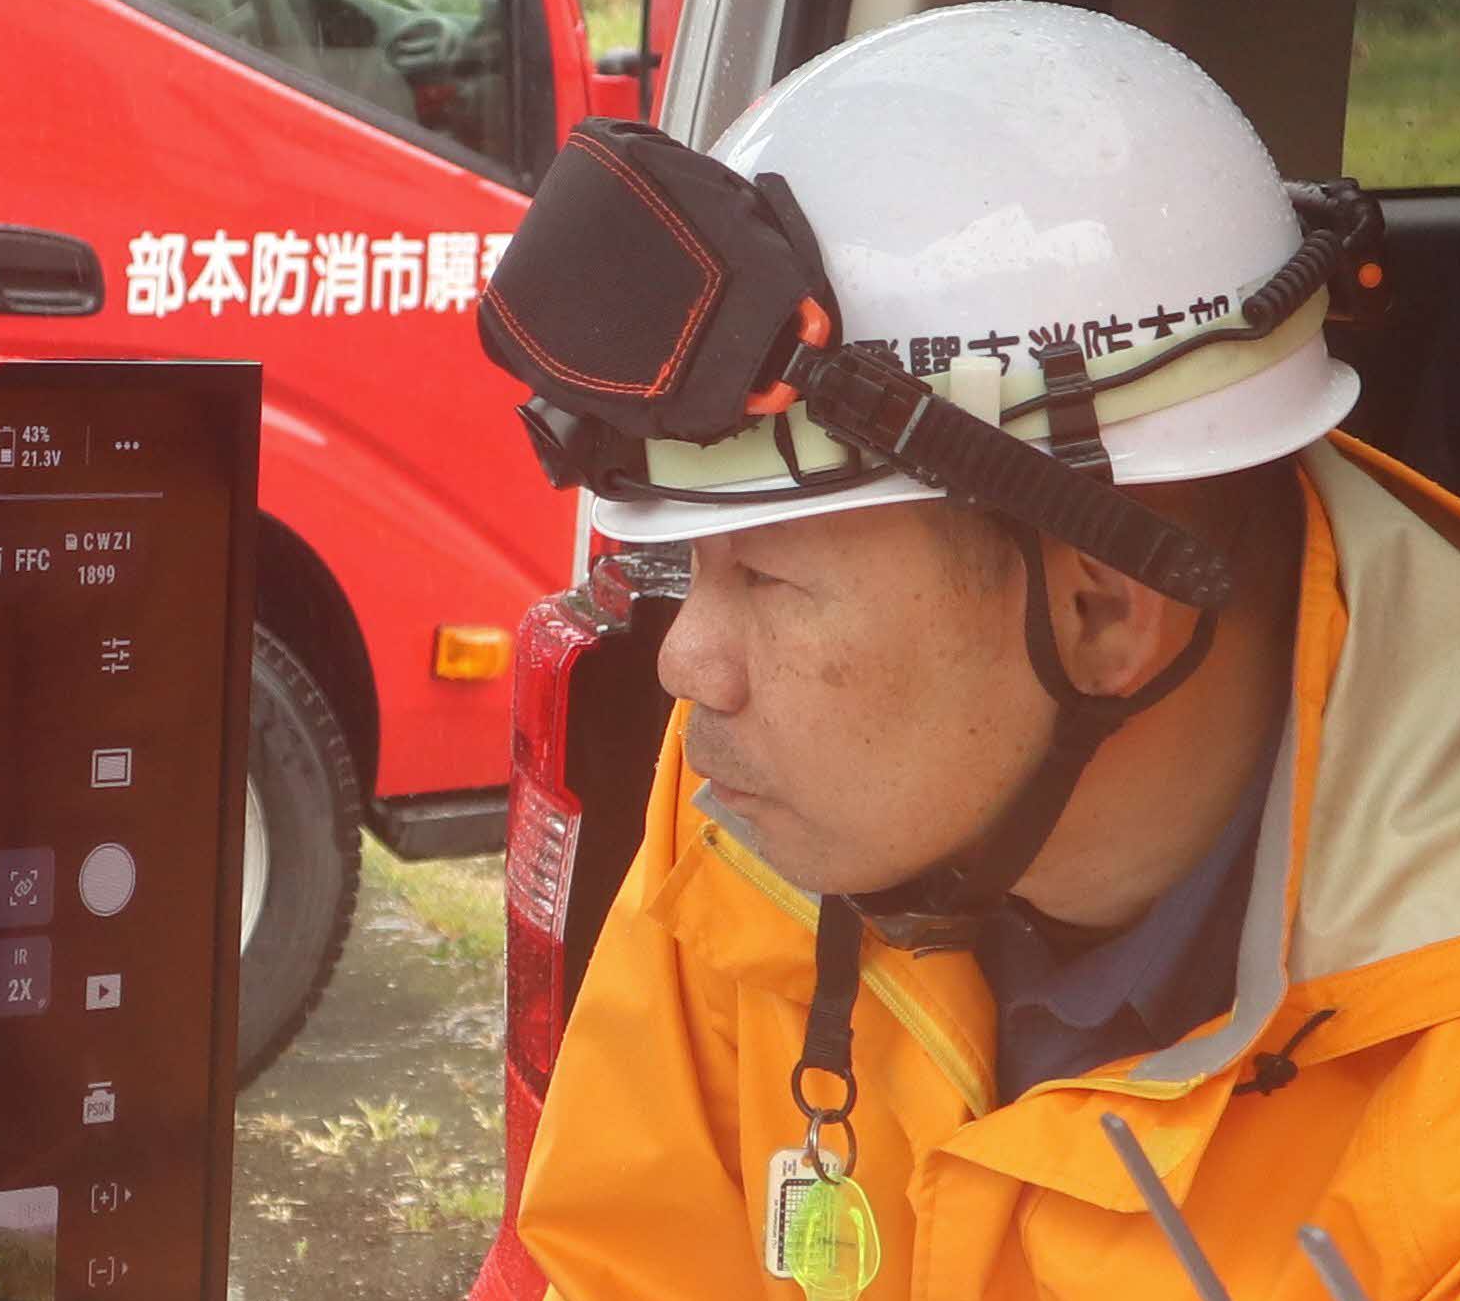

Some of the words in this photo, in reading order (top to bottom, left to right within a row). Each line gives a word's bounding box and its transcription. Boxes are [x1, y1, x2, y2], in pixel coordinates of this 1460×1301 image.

[22, 425, 51, 443] 43%
[21, 450, 63, 468] 21.3V
[15, 548, 51, 572] FFC
[78, 564, 116, 587] 1899
[13, 947, 29, 966] IR
[7, 977, 33, 1003] 2X
